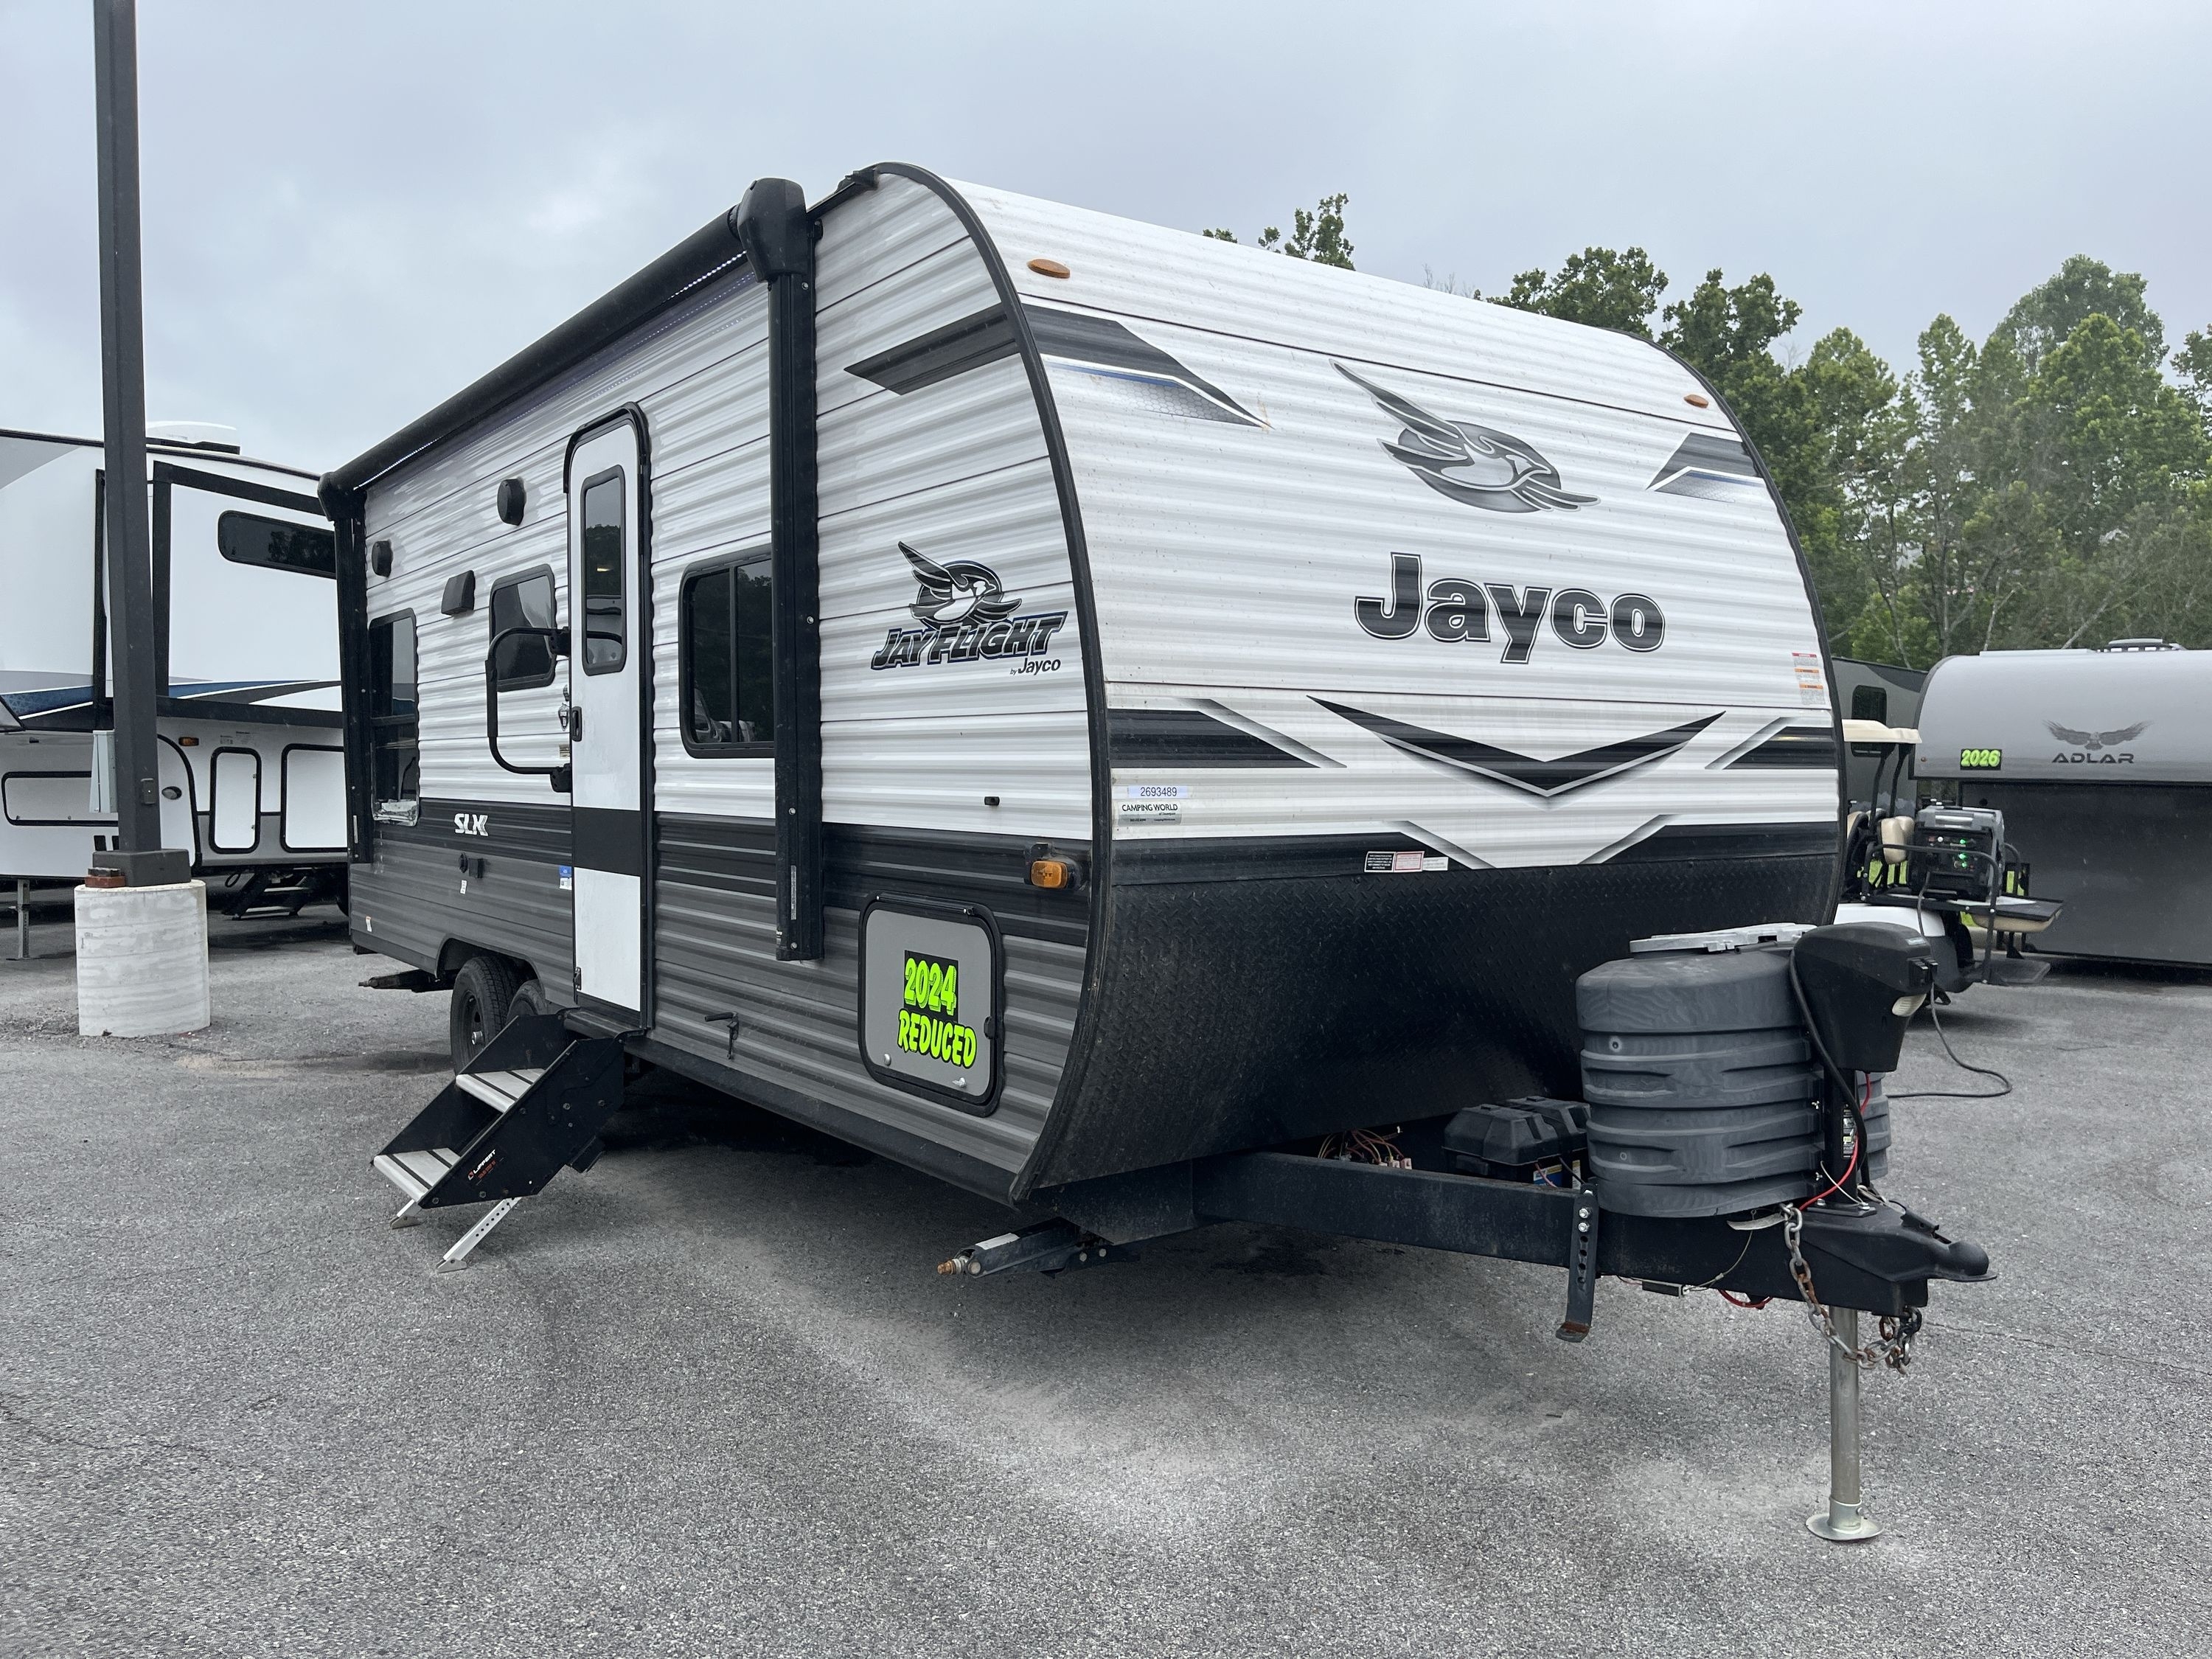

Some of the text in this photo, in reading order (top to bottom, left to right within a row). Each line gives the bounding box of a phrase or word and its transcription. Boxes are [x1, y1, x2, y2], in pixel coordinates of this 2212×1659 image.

[1354, 552, 1665, 664] Jayco
[1018, 658, 1061, 675] Jayco
[1961, 749, 2000, 767] 2026
[2051, 753, 2134, 764] ADLAR
[1140, 787, 1178, 796] 2693489
[454, 813, 488, 836] SLK
[904, 958, 957, 1016] 2024
[897, 1008, 978, 1068] REDUCED
